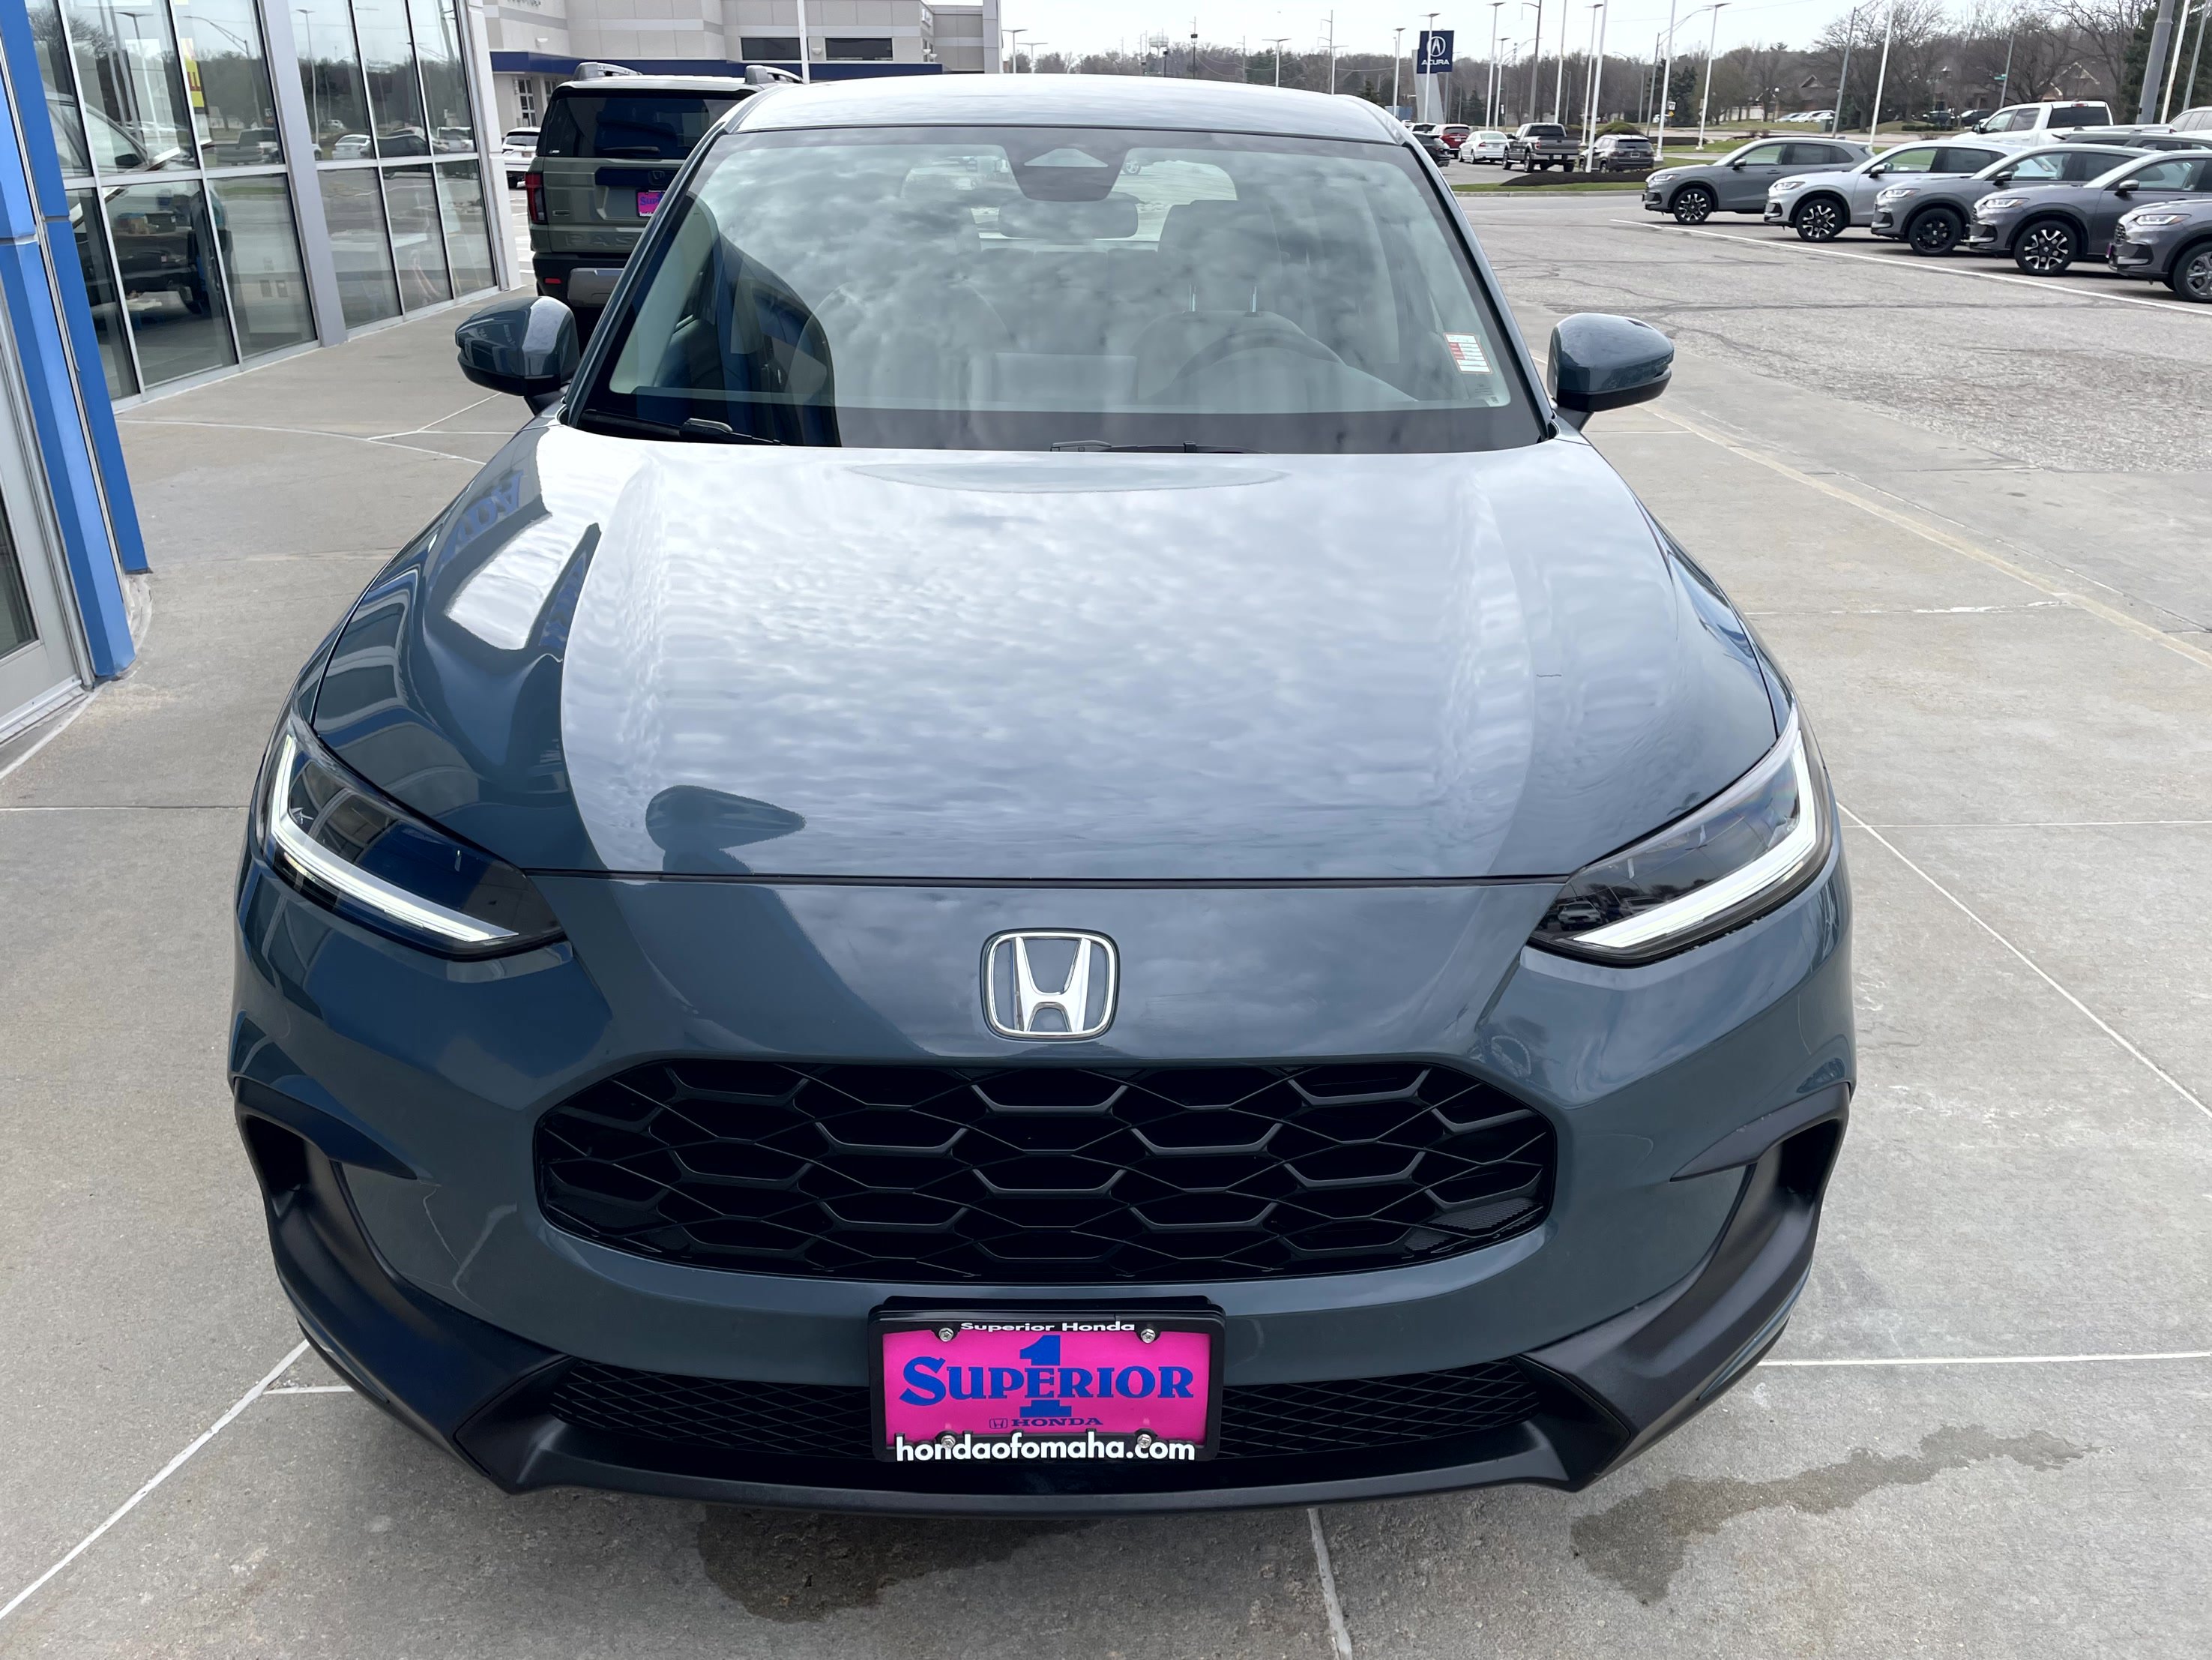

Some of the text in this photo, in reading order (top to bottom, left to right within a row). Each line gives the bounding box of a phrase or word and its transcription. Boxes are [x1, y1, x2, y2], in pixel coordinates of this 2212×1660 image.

[960, 1321, 1135, 1332] Superior Honda
[899, 1356, 1193, 1406] SUPERIOR
[1019, 1335, 1072, 1417] 1
[1012, 1418, 1103, 1426] HONDA
[896, 1431, 1195, 1461] hondaofomaha.com
